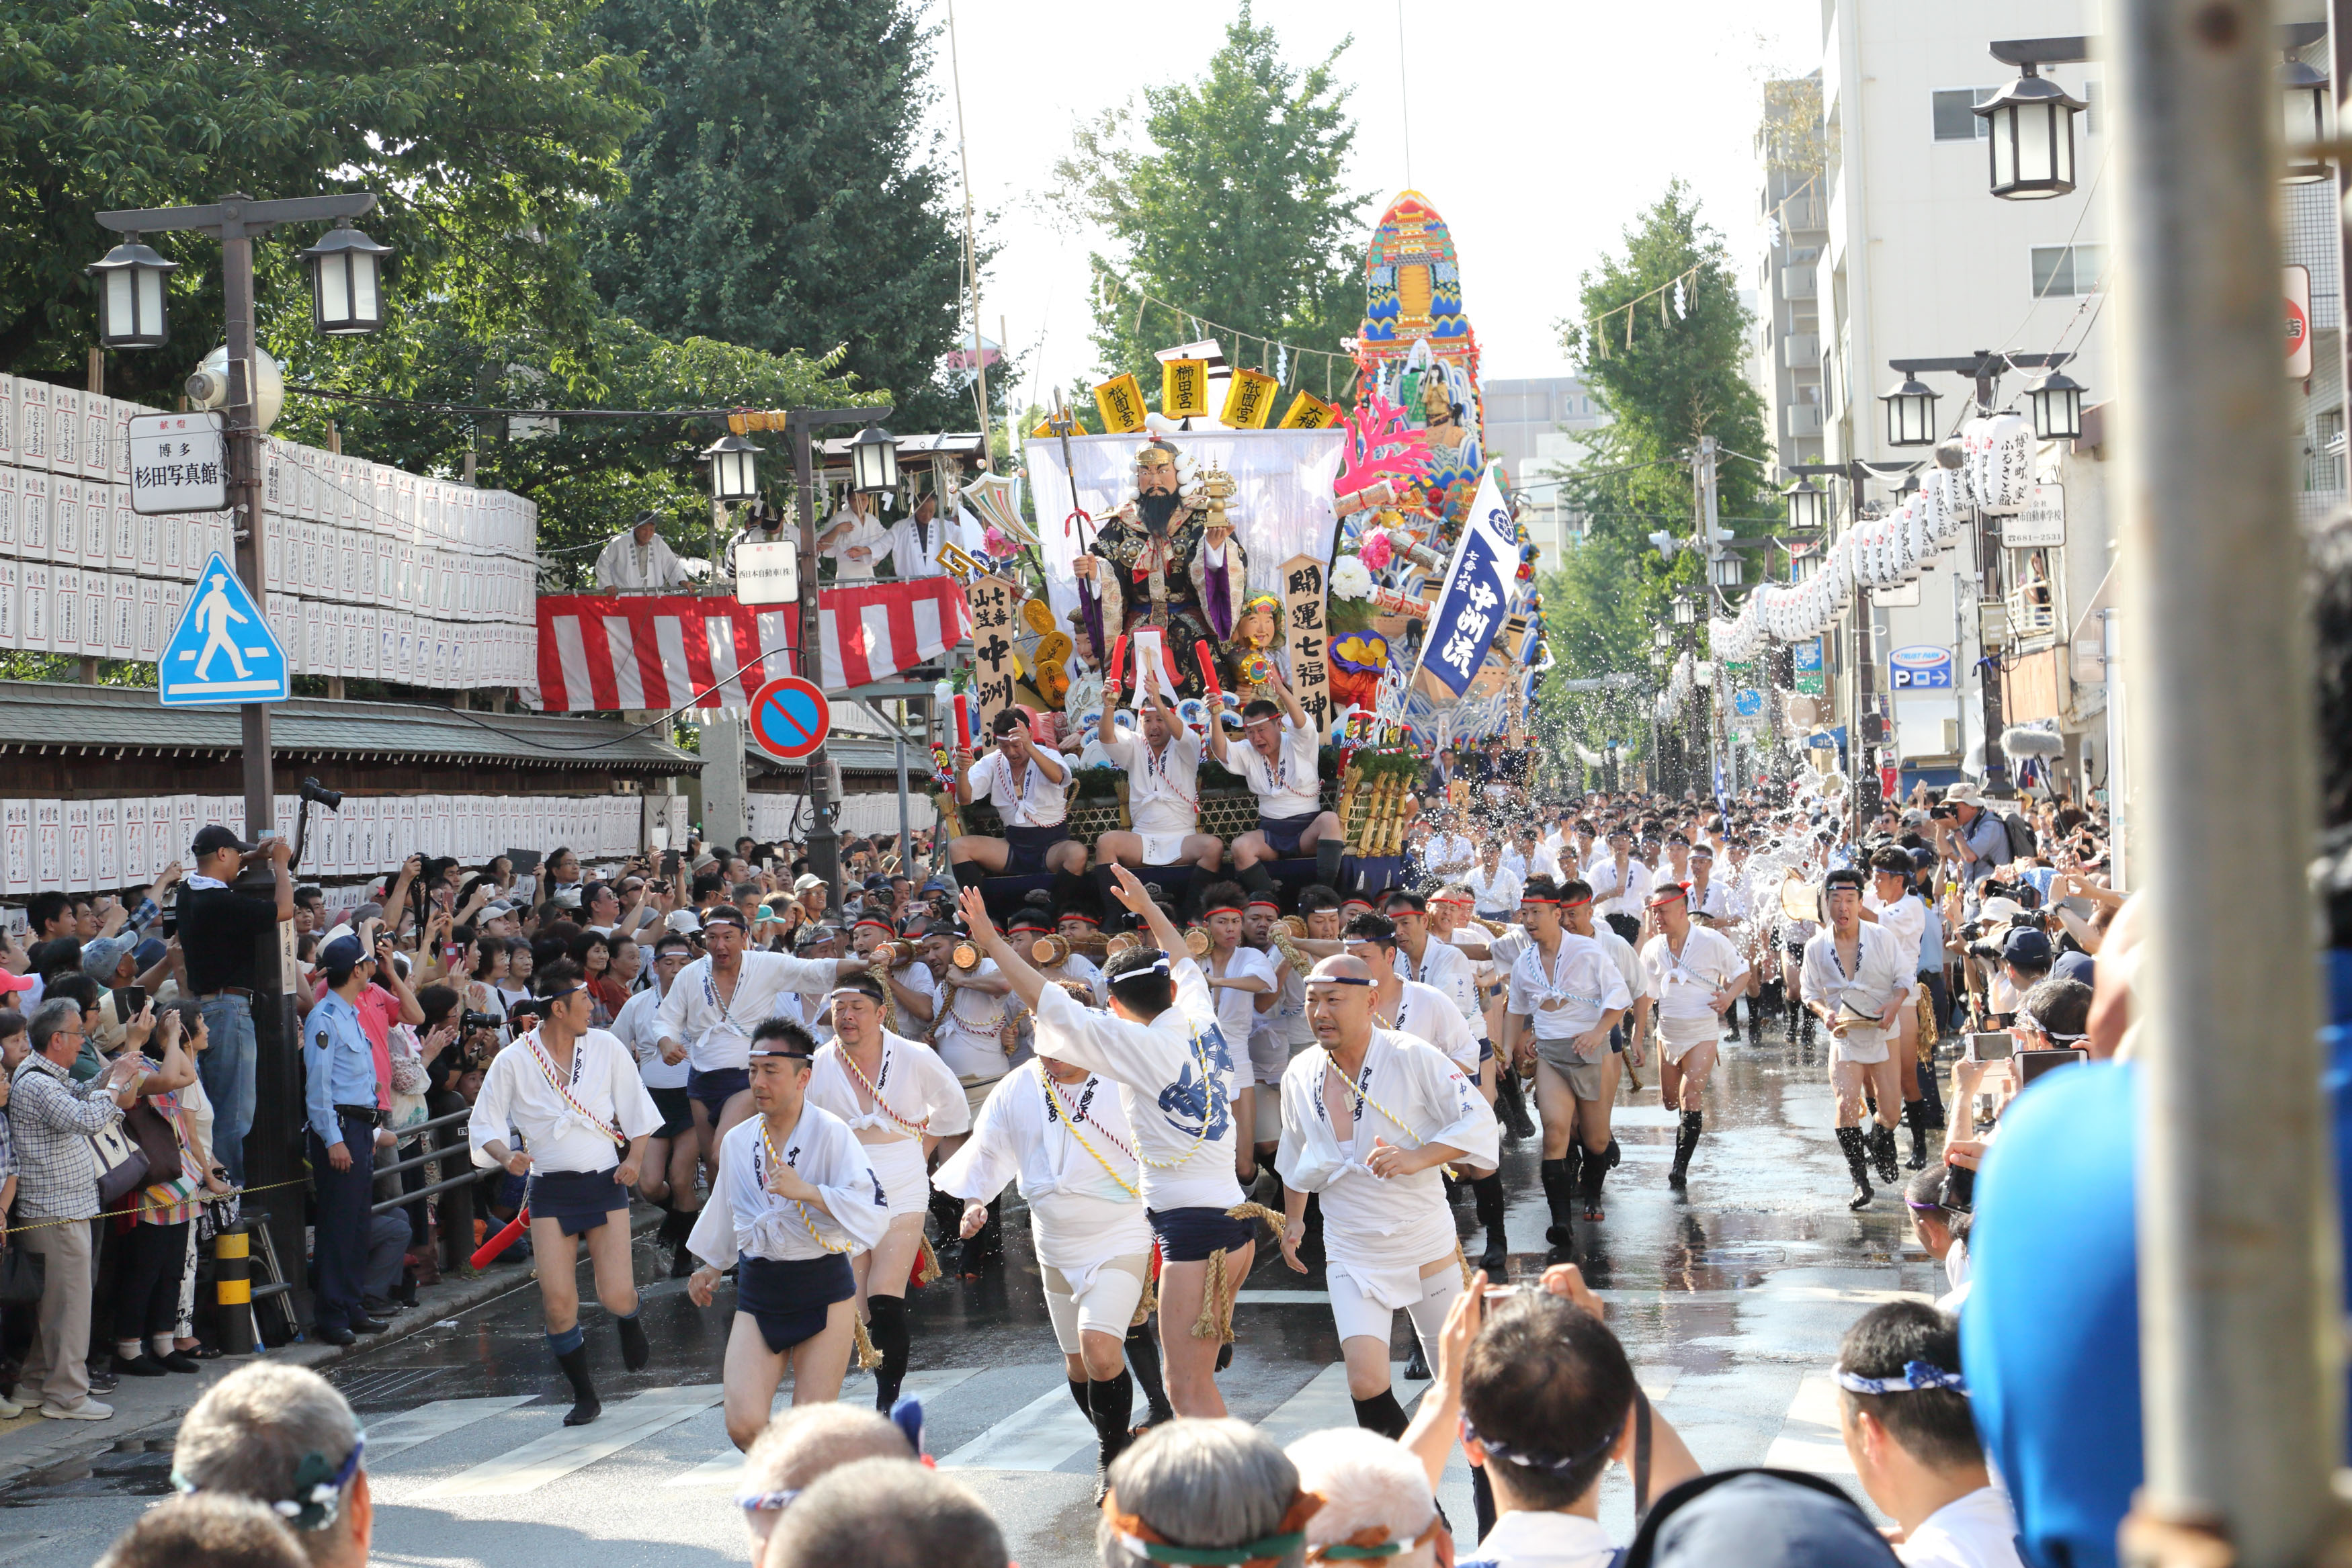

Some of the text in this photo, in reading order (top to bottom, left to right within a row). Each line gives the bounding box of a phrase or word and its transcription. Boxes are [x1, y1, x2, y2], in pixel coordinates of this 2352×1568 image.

[1108, 385, 1134, 427] 祇園宮
[1175, 365, 1193, 408] 櫛田宮
[1236, 379, 1261, 423] 祇園宮
[159, 443, 190, 457] 博多
[135, 462, 217, 489] 杉田写真館
[1999, 441, 2014, 507] ふるさと館
[739, 568, 794, 578] 西日本自動車(株)
[1456, 550, 1480, 593] 七番山笠
[1289, 565, 1327, 732] 開運七福神
[1442, 580, 1498, 679] 中洲流
[1895, 670, 1910, 688] P
